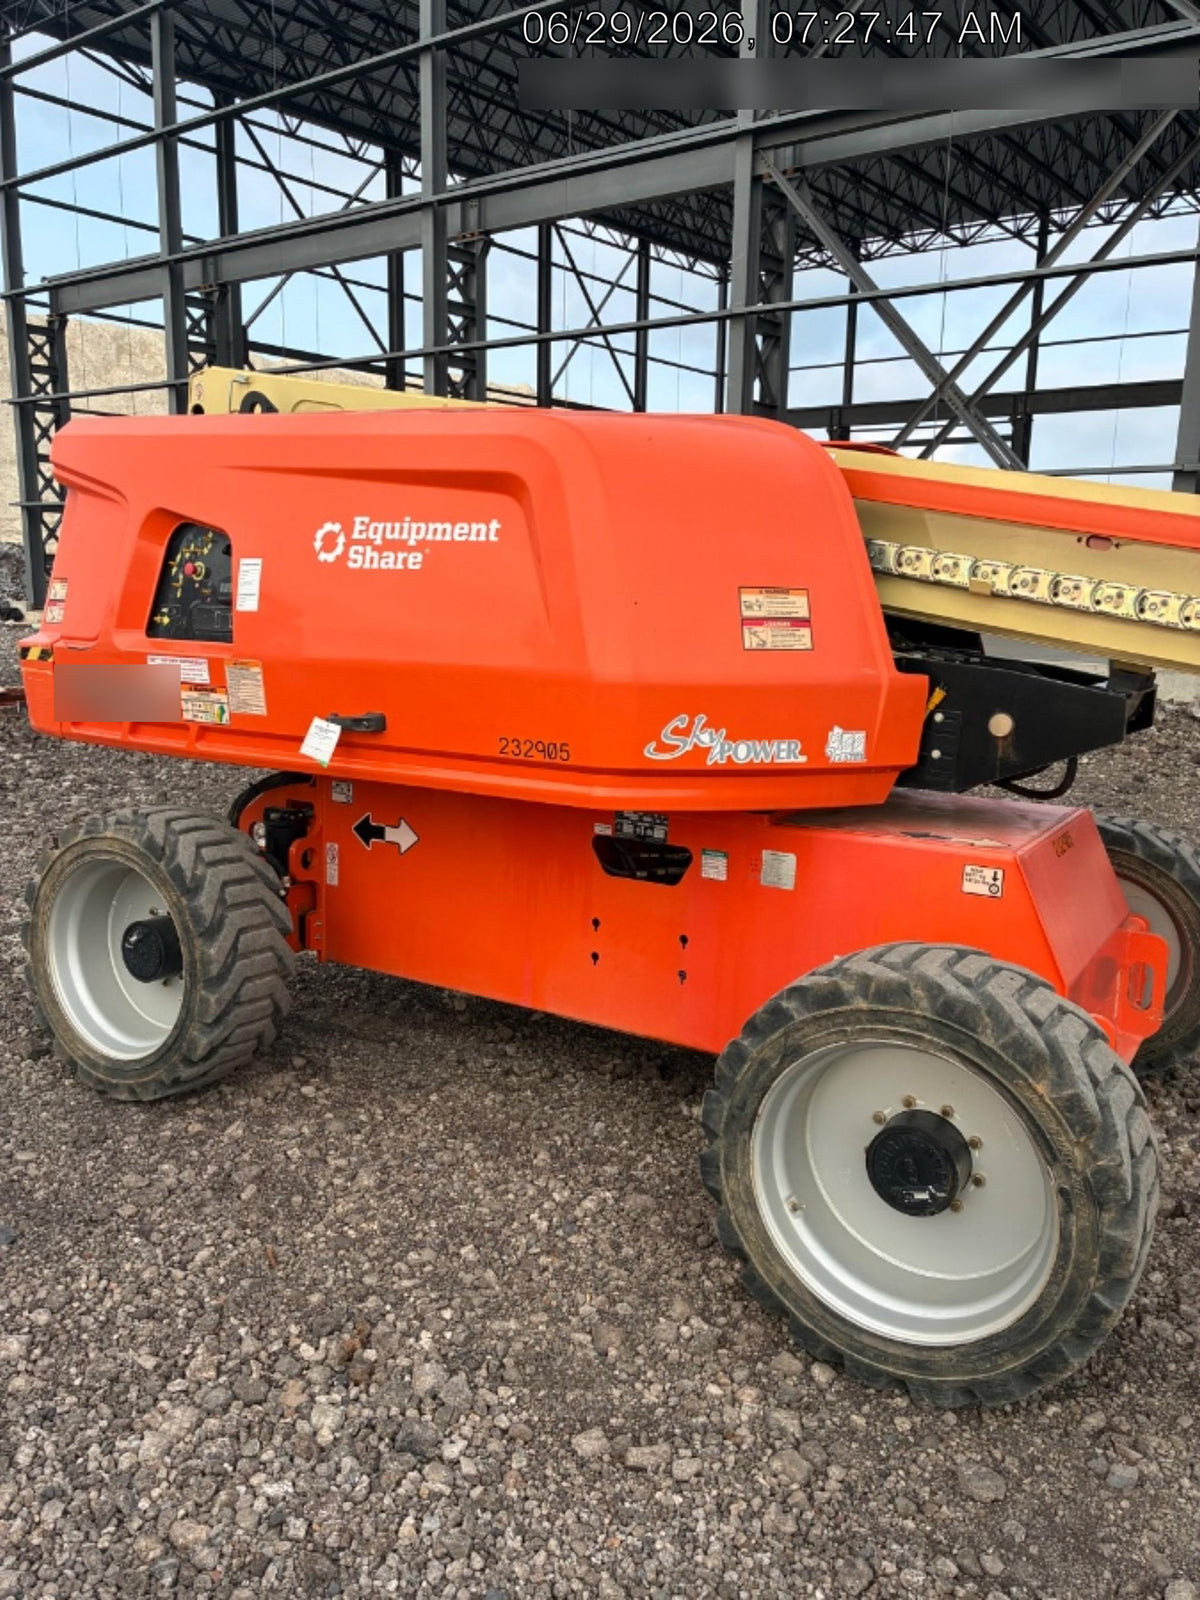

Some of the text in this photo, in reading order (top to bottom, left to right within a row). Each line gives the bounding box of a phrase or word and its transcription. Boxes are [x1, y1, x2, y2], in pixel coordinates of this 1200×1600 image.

[351, 516, 502, 546] Equipment
[346, 545, 424, 570] Share
[498, 737, 570, 762] 232905
